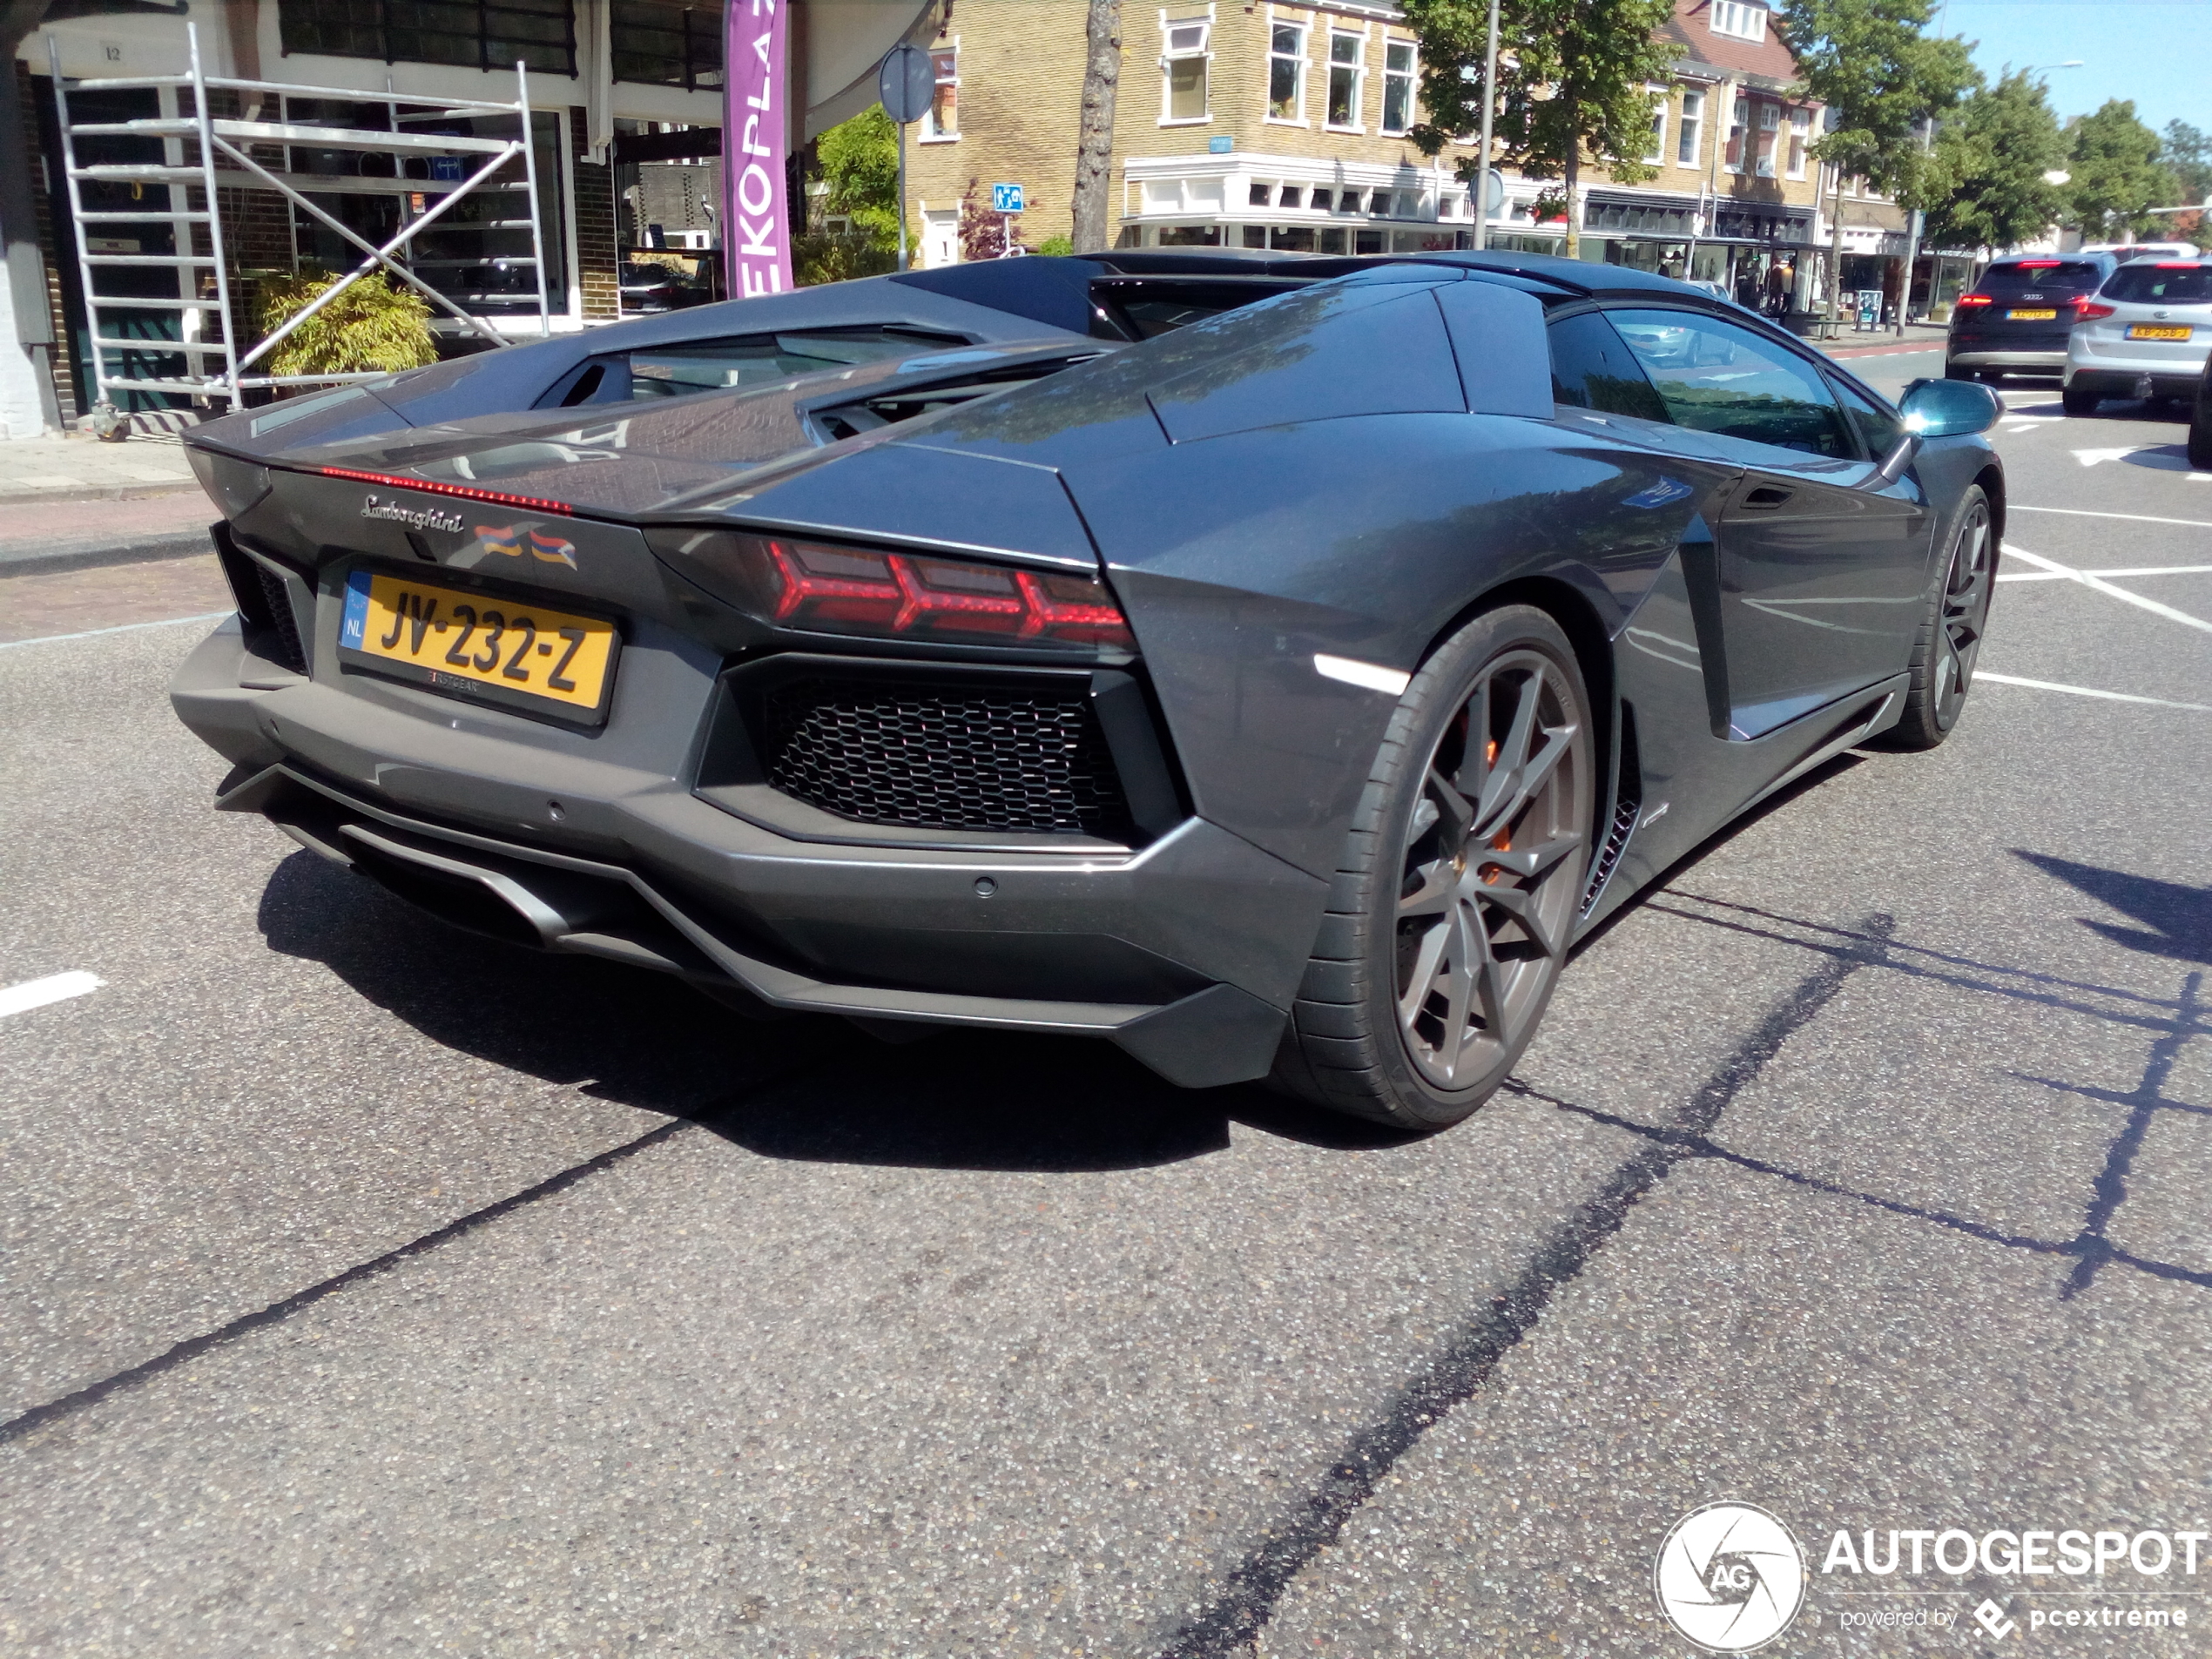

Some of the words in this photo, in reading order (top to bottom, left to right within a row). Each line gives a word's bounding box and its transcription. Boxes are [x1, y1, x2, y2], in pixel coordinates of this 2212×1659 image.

[105, 46, 121, 61] 12
[361, 494, 464, 533] Lamborghini
[347, 618, 361, 638] NL
[381, 592, 586, 691] JV-232-Z
